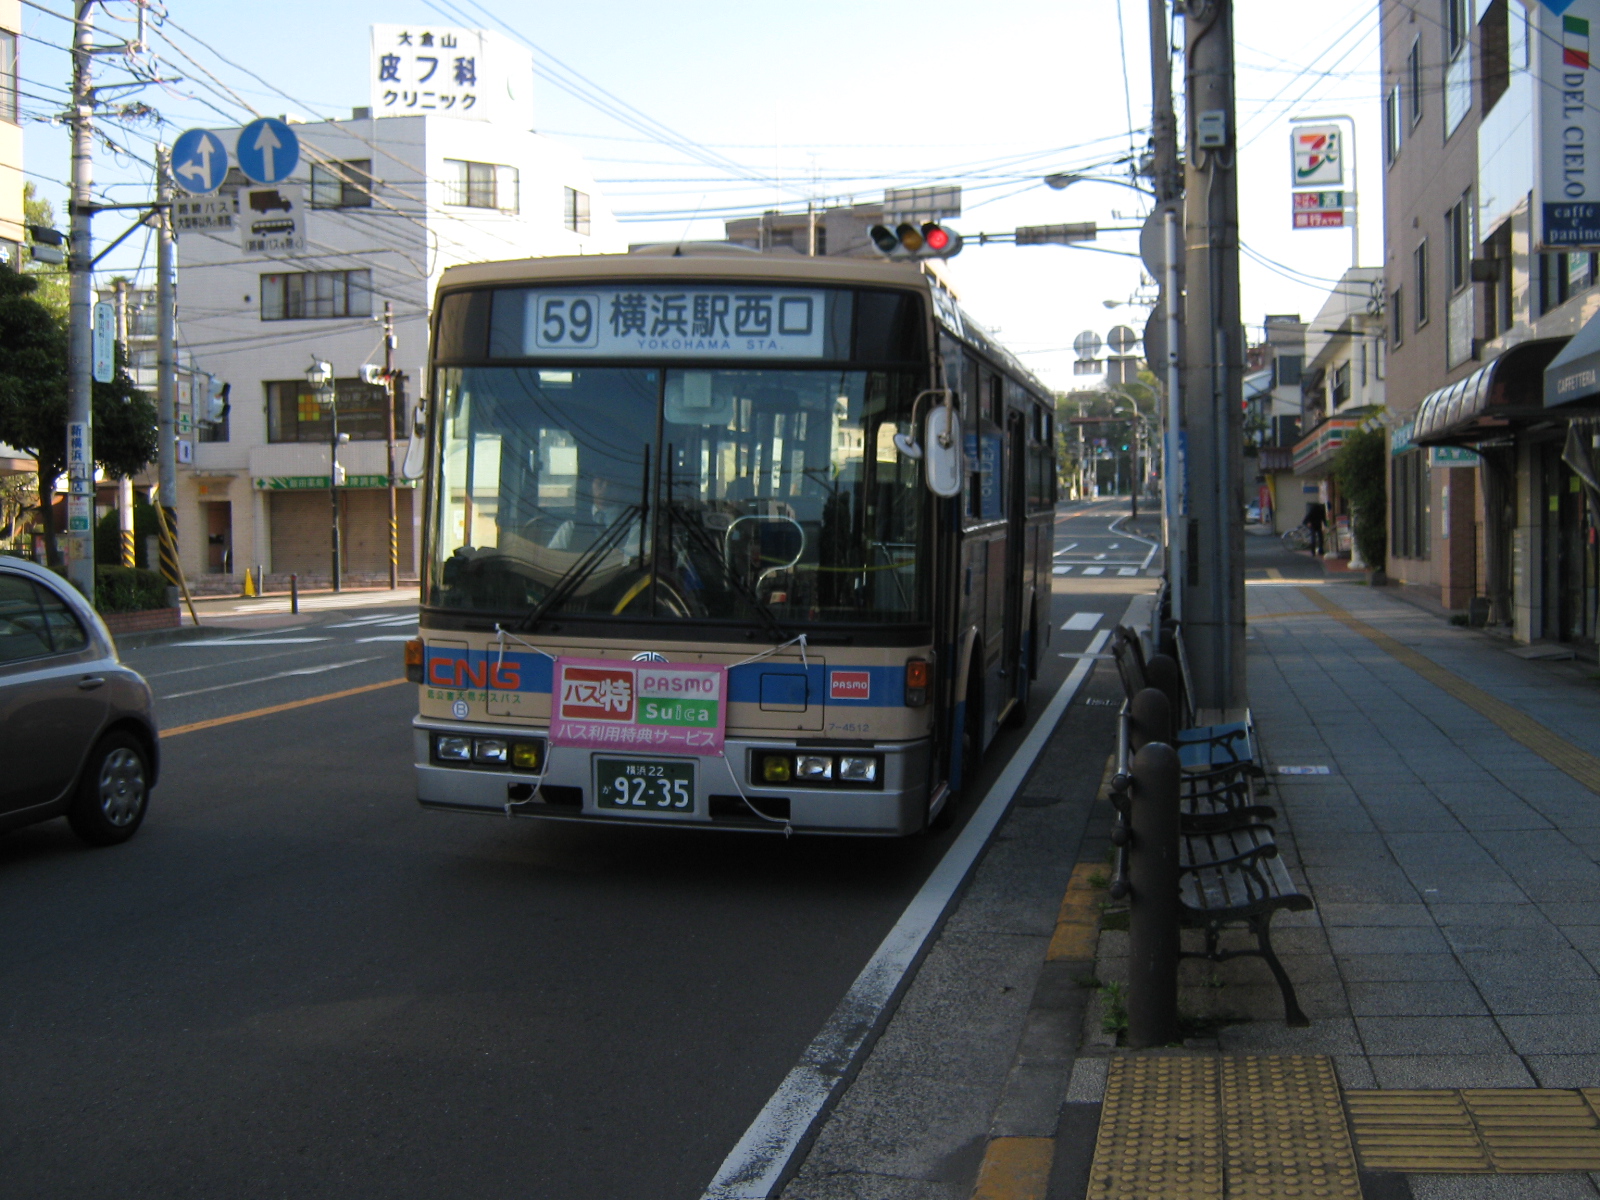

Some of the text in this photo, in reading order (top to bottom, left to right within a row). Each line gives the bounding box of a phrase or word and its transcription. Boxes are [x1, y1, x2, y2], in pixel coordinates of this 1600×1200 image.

[398, 31, 457, 49] 大倉山
[379, 52, 477, 86] 皮フ科
[383, 90, 477, 110] クリニック
[1563, 73, 1585, 198] DEL CIELO
[1571, 218, 1580, 227] e
[543, 293, 813, 343] 59 横浜駅西口
[637, 339, 784, 350] YOKOHAMA STA.
[430, 657, 520, 690] CNG
[644, 676, 714, 693] PASMO
[833, 681, 868, 689] PASMO
[645, 703, 709, 721] Suica
[557, 724, 716, 747] バス利用特典サービス
[829, 723, 870, 732] 7-4512
[614, 776, 689, 808] 92-35
